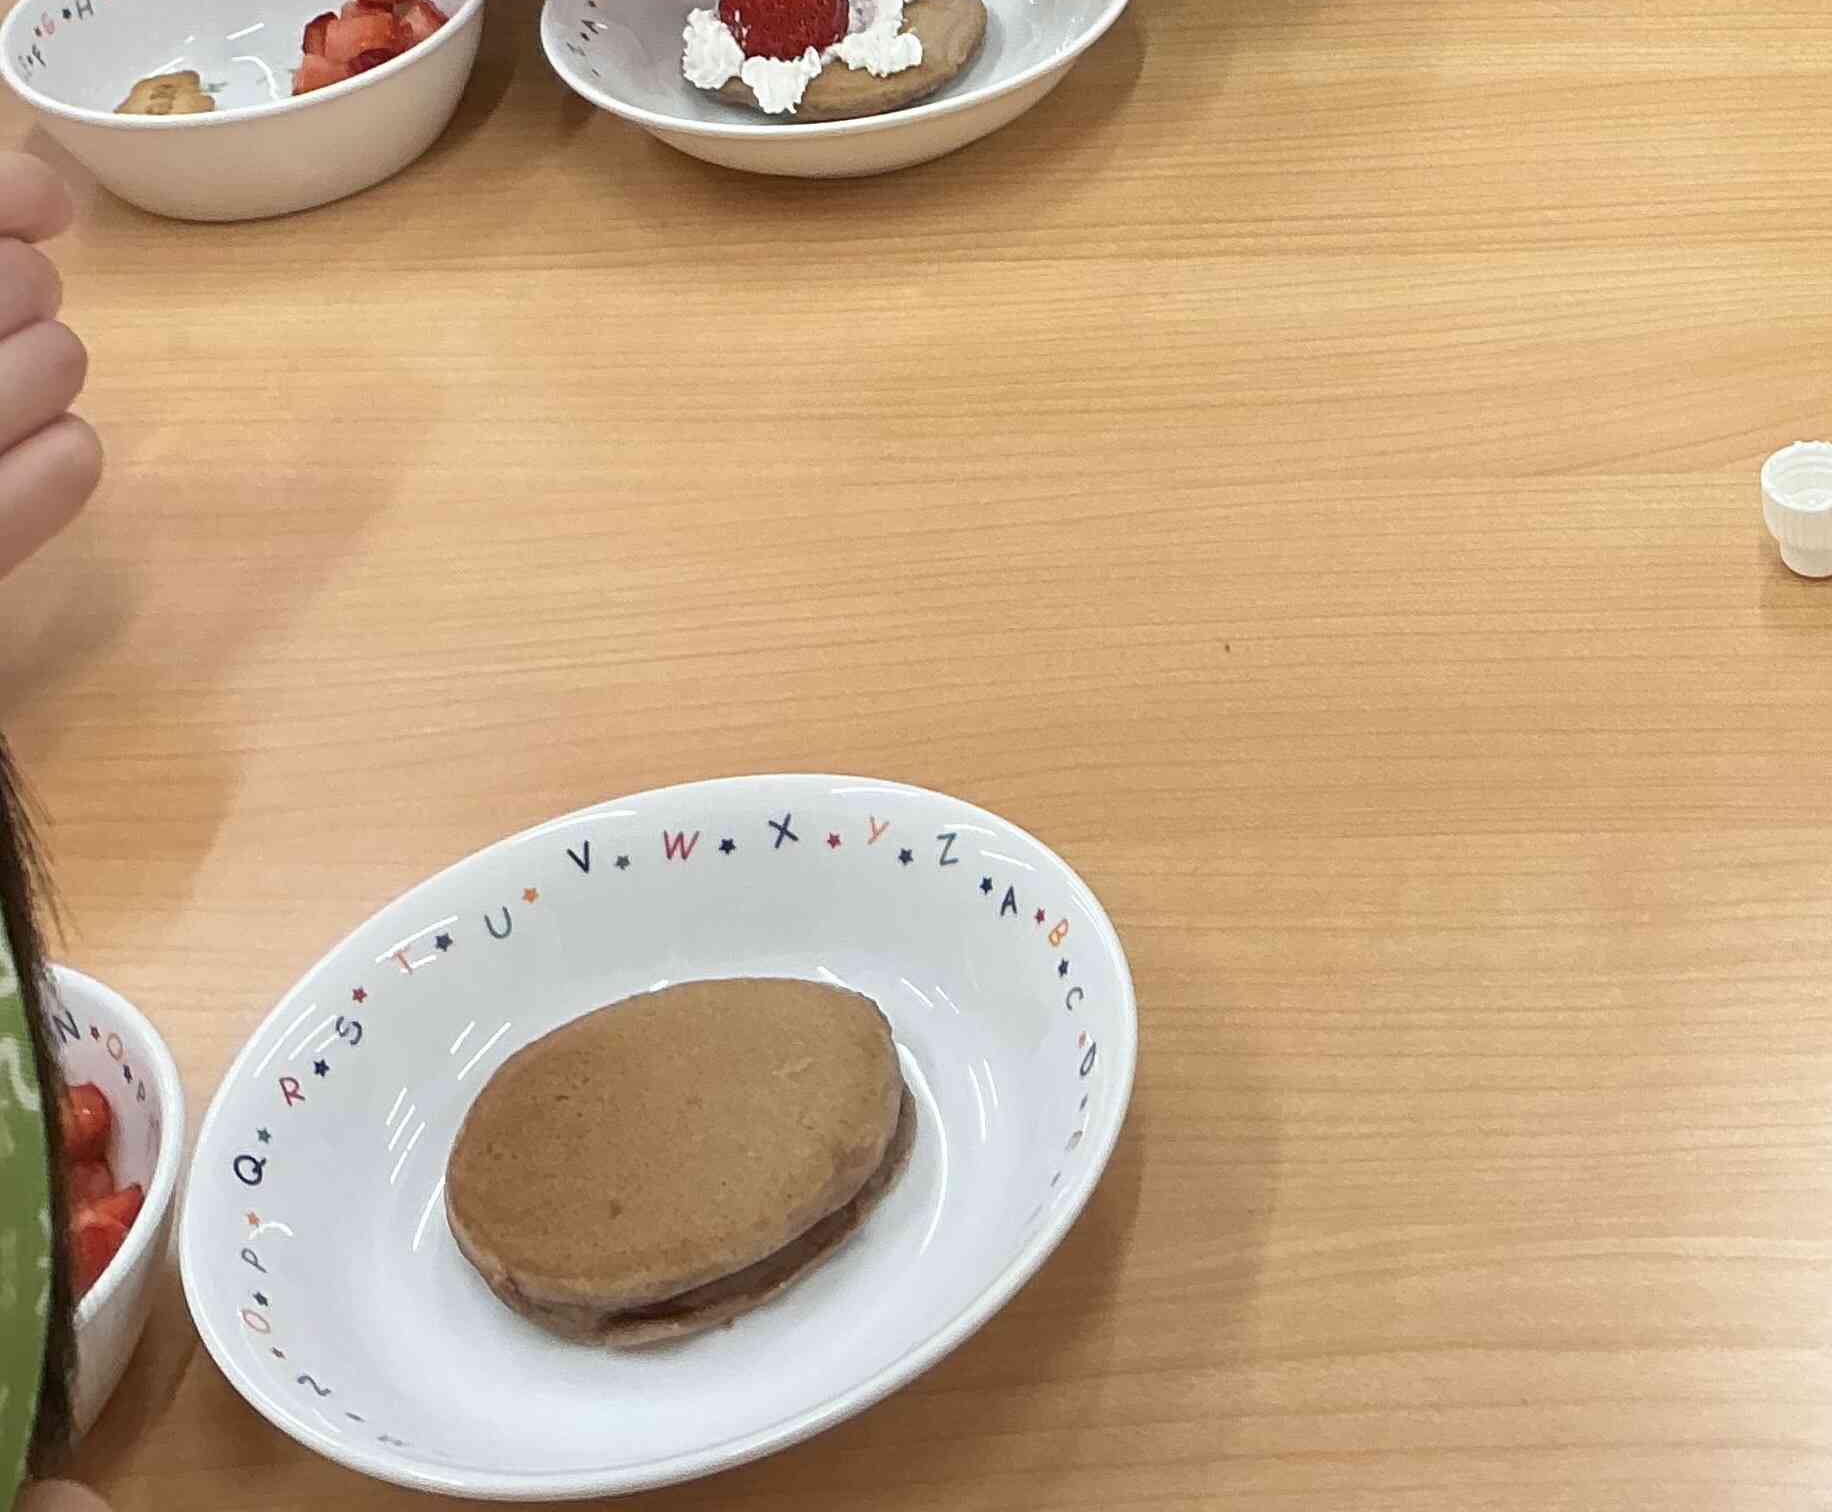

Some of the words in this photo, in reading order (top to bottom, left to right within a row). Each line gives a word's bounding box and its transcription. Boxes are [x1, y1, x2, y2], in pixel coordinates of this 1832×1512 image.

[768, 814, 797, 849] X
[865, 817, 889, 844] Y
[568, 842, 591, 873] V
[662, 830, 701, 862] W
[937, 833, 959, 866] Z
[1000, 886, 1018, 916] A
[484, 908, 512, 940] U
[1048, 919, 1069, 947] B
[1066, 986, 1084, 1011] C
[337, 1015, 363, 1045] S
[106, 1033, 123, 1061] O
[279, 1076, 306, 1106] R
[233, 1155, 267, 1185] Q
[241, 1248, 268, 1274] P
[242, 1309, 271, 1334] O
